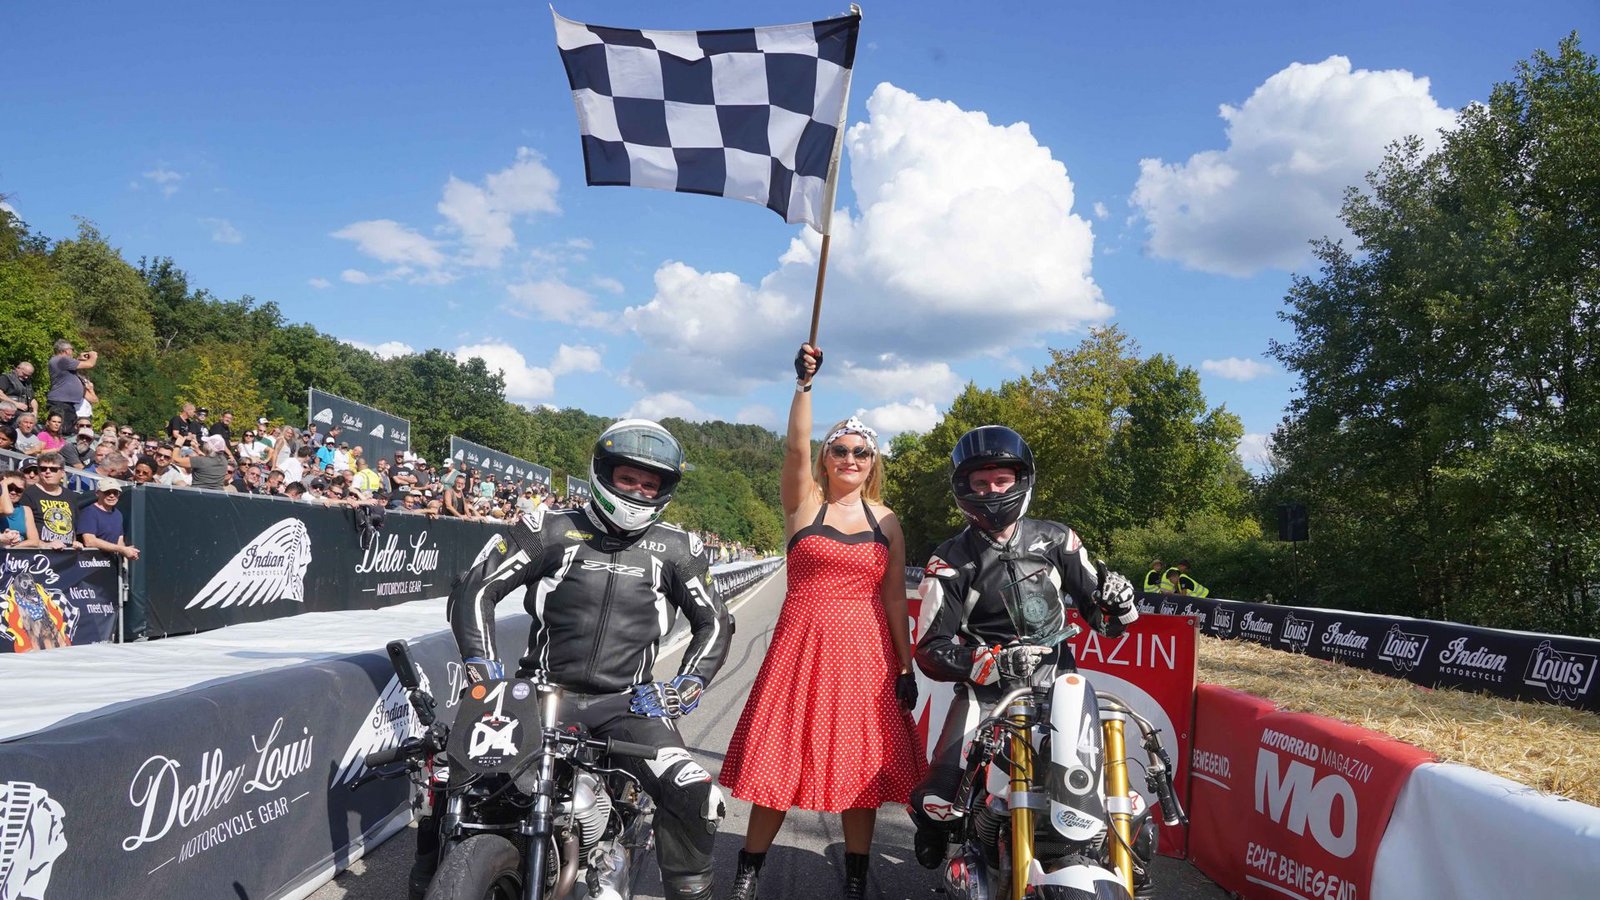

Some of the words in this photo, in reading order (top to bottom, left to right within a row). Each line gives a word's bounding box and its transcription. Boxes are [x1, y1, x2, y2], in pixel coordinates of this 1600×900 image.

[39, 499, 72, 517] SUPER
[241, 544, 285, 569] Indian
[355, 530, 407, 574] Detlev
[406, 530, 440, 576] Louis
[28, 554, 61, 585] Dog
[242, 569, 284, 577] MOTORCYCLE
[69, 587, 89, 600] Nice
[88, 588, 96, 599] to
[376, 581, 409, 596] MOTORCYCLE
[408, 580, 422, 593] GEAR
[86, 603, 102, 614] meet
[102, 602, 115, 617] you!
[1213, 609, 1230, 629] Louis
[1240, 611, 1273, 635] Indian
[1241, 632, 1271, 642] MOTORCYCLE
[1283, 617, 1308, 641] Louis
[1321, 621, 1369, 650] Indian
[1321, 646, 1365, 659] MOTORCYCLE
[1383, 632, 1419, 659] Louis
[1439, 637, 1508, 672] Indian
[1439, 666, 1503, 683] MOTORCYCLE
[1531, 651, 1585, 685] Louis
[372, 699, 410, 729] Indian
[483, 681, 508, 722] 1
[1077, 714, 1099, 772] 4
[1260, 728, 1320, 761] MOTORRAD
[1320, 747, 1374, 784] MAGAZIN
[122, 748, 246, 851] Detlev
[243, 717, 314, 794] Louis
[1255, 747, 1358, 858] MO
[178, 810, 257, 864] MOTORCYCLE
[258, 796, 290, 824] GEAR
[1246, 841, 1277, 876] ECHT.
